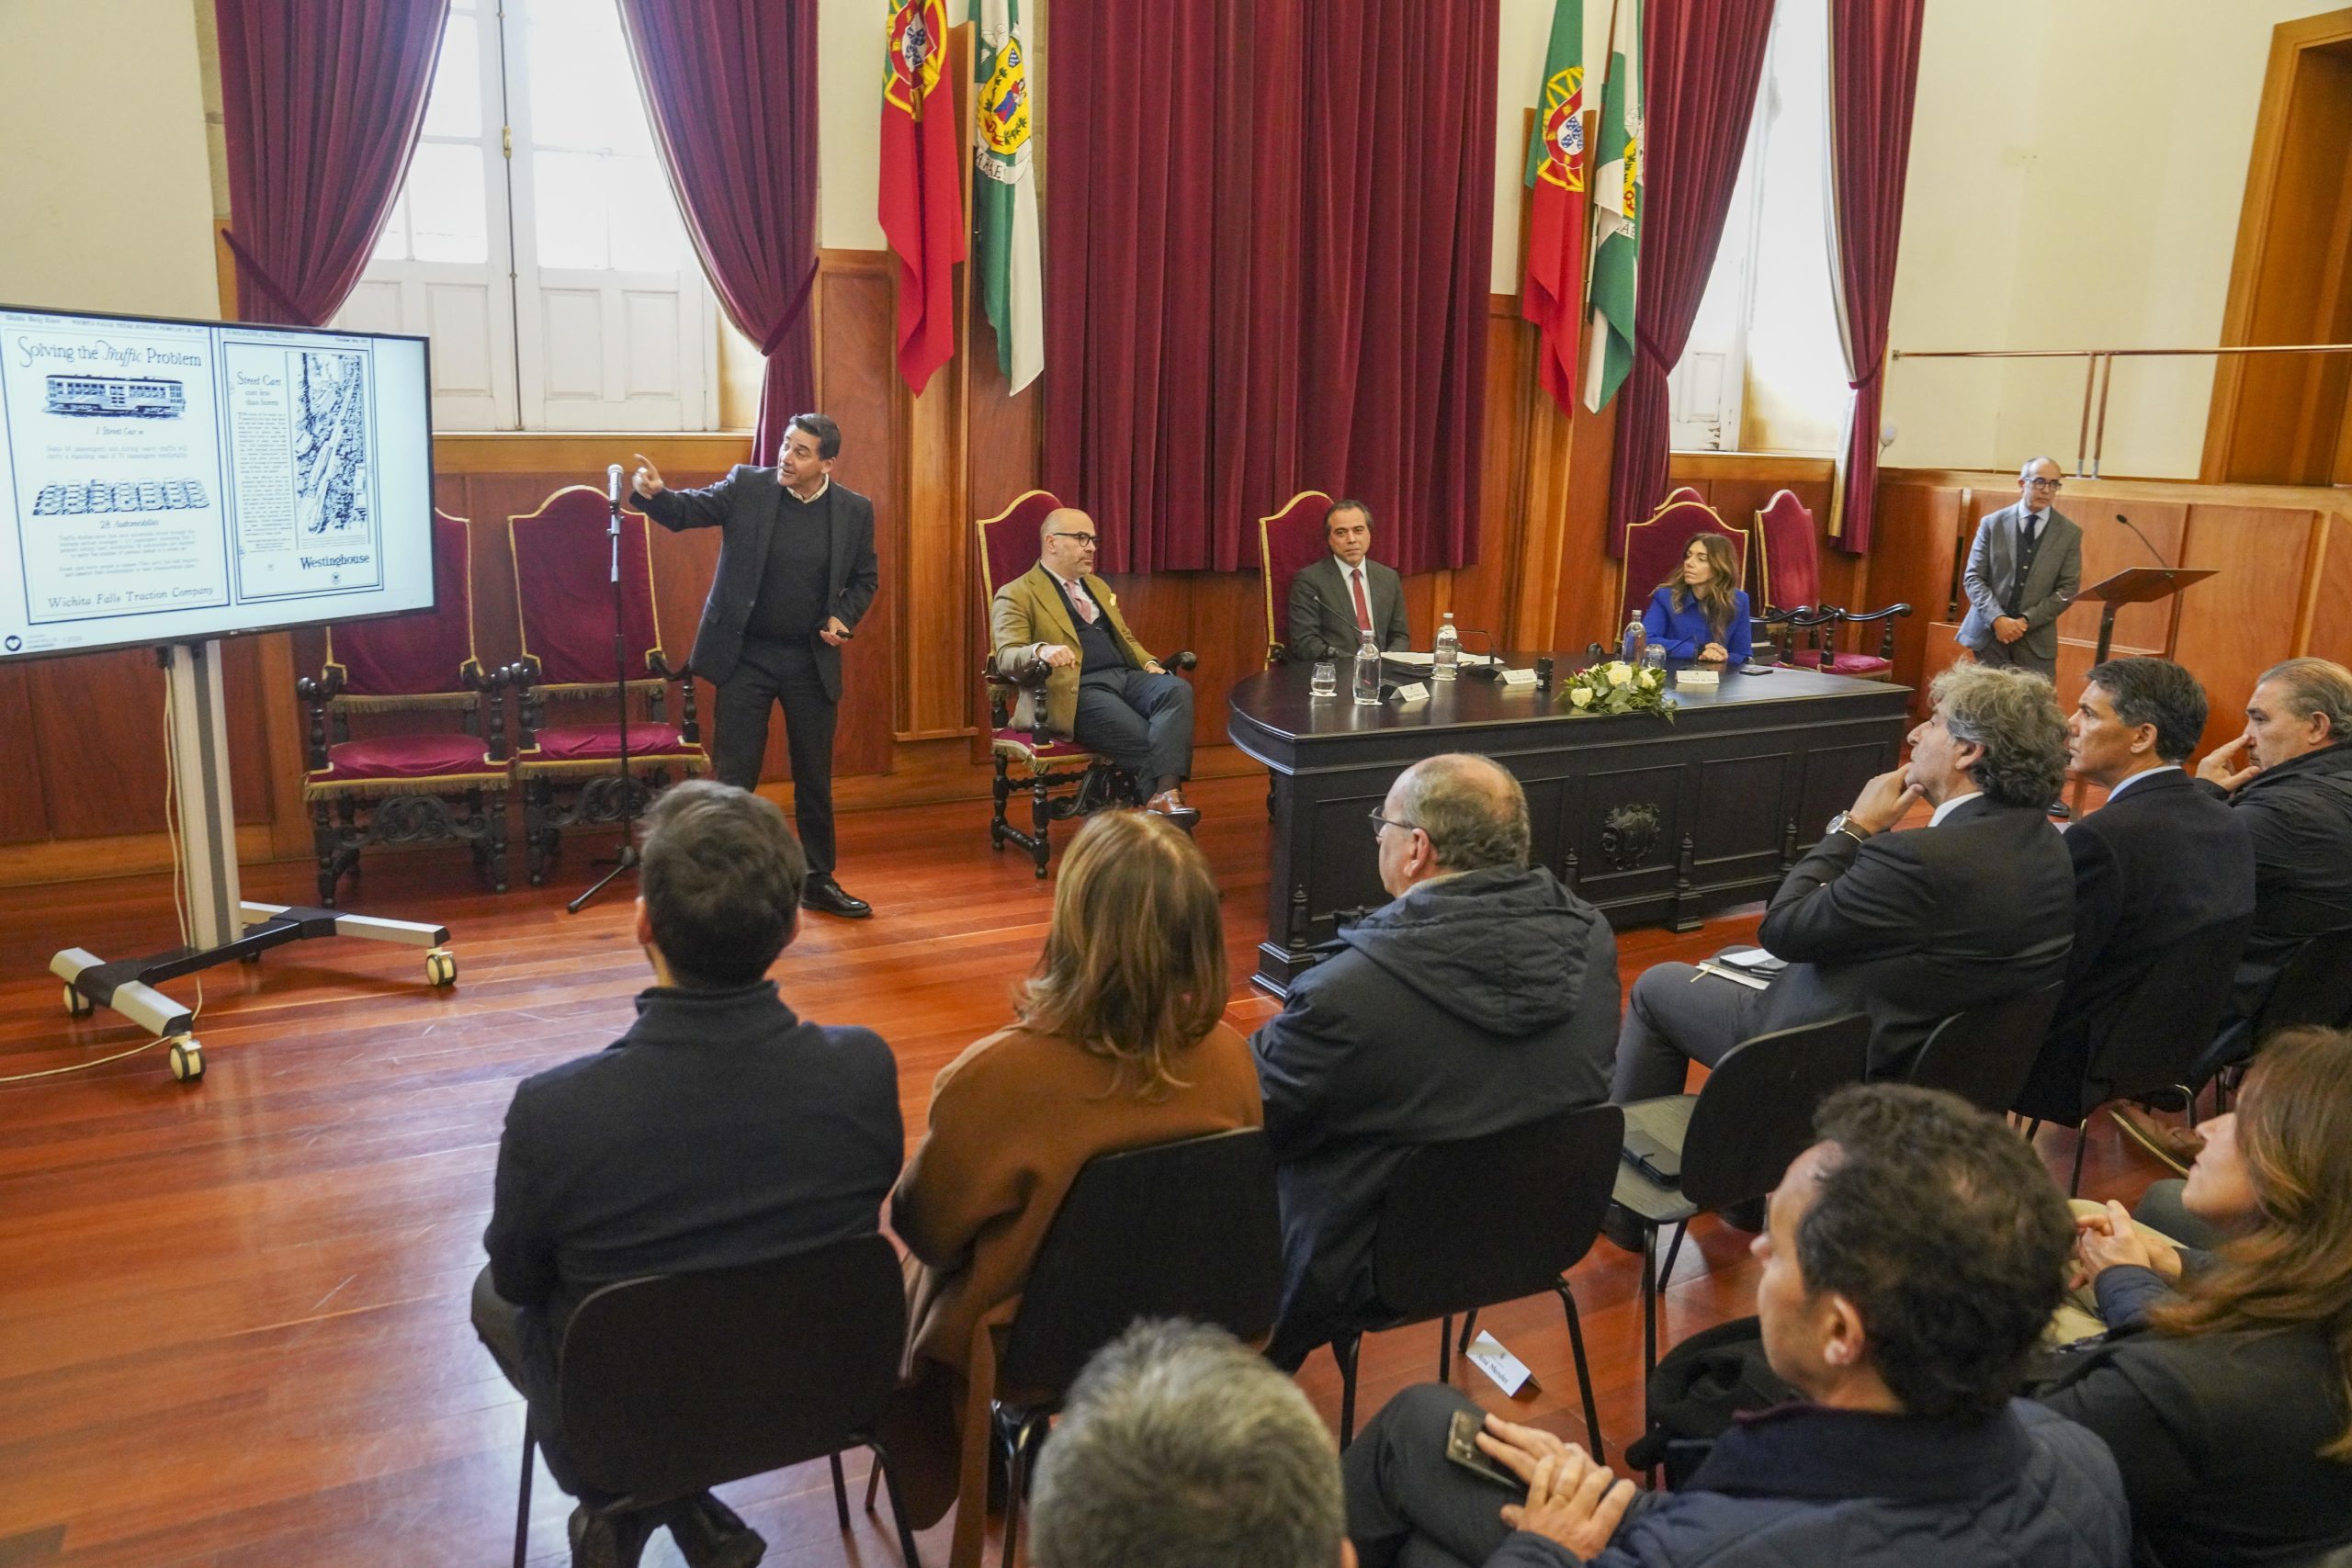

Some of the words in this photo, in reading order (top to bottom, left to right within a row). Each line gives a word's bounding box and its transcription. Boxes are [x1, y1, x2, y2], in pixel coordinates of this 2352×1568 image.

[17, 336, 74, 367] Solving
[78, 345, 98, 360] the
[96, 340, 142, 367] Traffic
[147, 347, 202, 367] Problem
[237, 371, 260, 385] Street
[102, 426, 122, 435] Street
[99, 520, 111, 529] 28
[113, 518, 160, 528] Automobiles
[300, 554, 370, 570] Westinghouse
[48, 596, 91, 608] Wichita
[96, 592, 120, 604] Falls
[125, 590, 168, 602] Traction
[172, 587, 214, 598] Company
